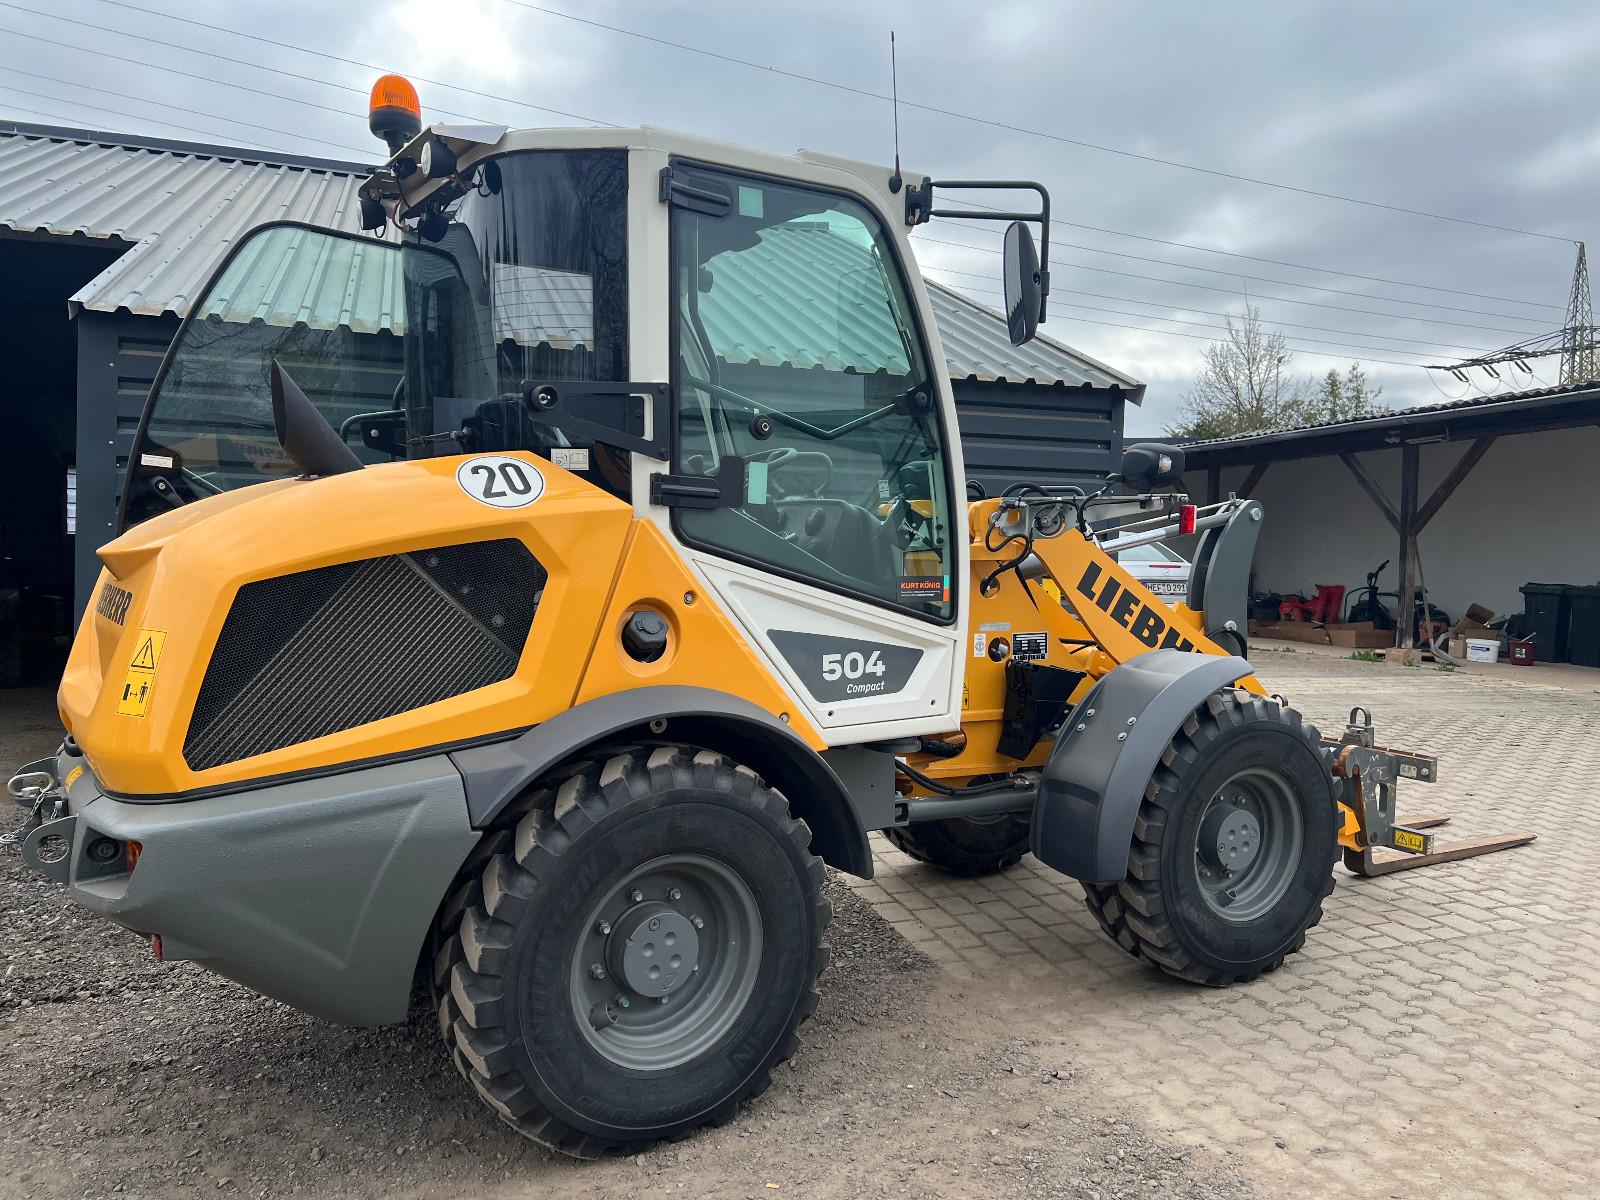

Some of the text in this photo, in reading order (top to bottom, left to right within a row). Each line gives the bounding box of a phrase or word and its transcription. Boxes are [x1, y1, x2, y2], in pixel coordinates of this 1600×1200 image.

[472, 462, 533, 499] 20
[900, 580, 941, 590] KURT KÖNIG
[1147, 584, 1162, 592] HEF
[1173, 584, 1186, 592] 291
[1077, 561, 1204, 654] LIEBH
[822, 650, 886, 681] 504
[846, 680, 885, 693] Compact
